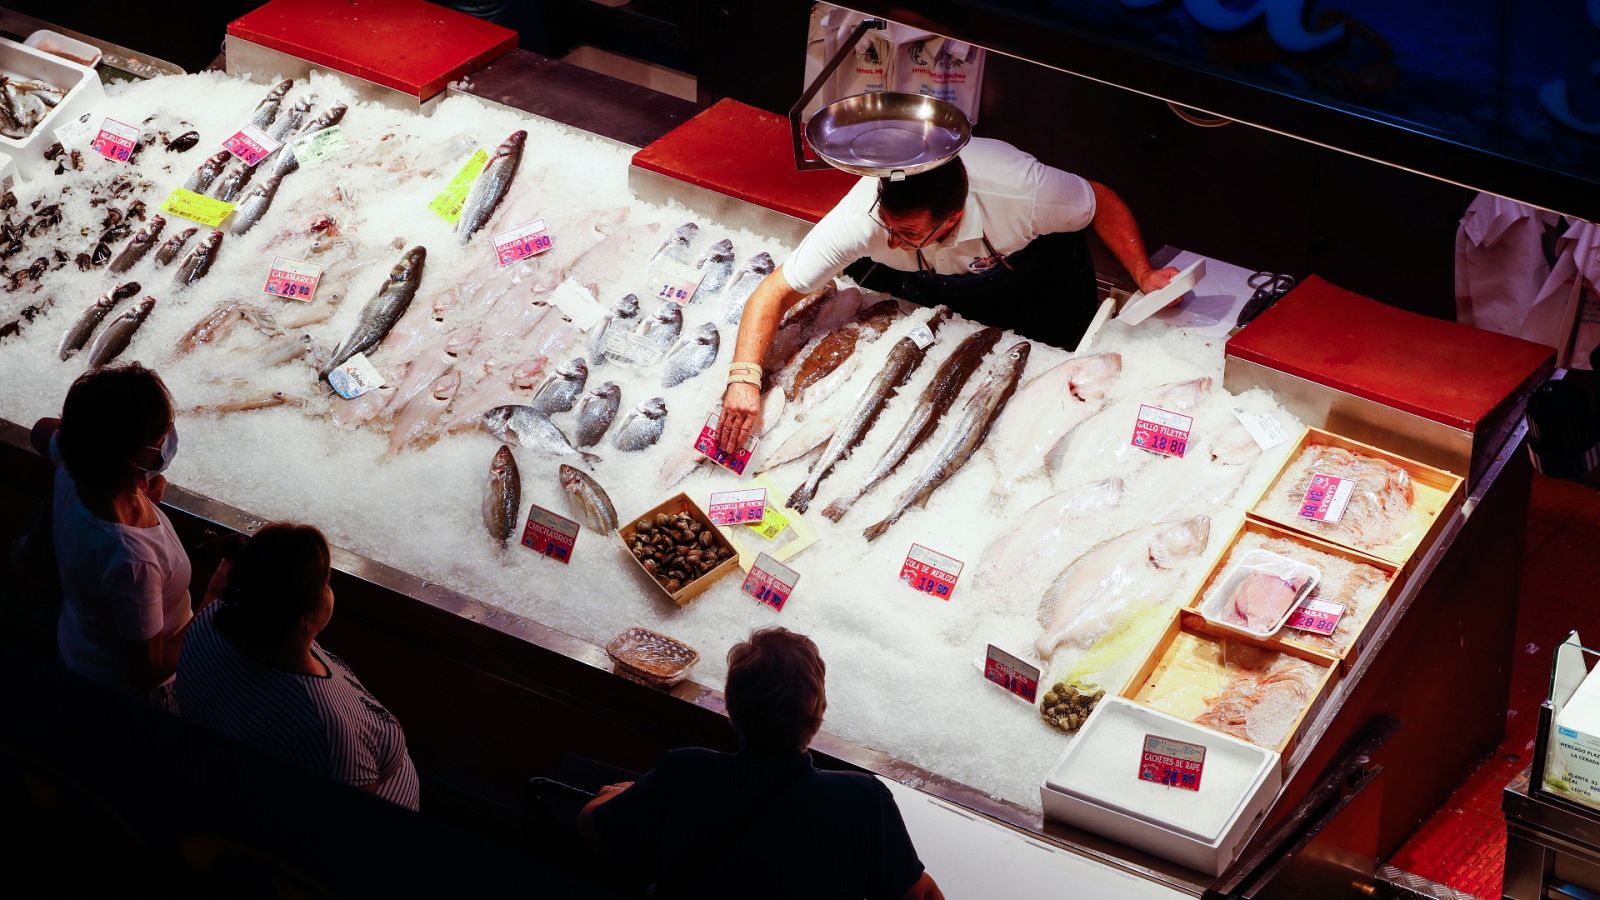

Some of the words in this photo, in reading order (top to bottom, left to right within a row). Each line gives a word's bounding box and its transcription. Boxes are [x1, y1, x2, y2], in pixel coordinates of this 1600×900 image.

[497, 239, 521, 251] GALLOS
[271, 270, 315, 283] CALAMARES
[1137, 420, 1158, 432] GALLO
[1160, 426, 1187, 439] FILETES
[1318, 484, 1336, 512] GAMBAS
[528, 521, 573, 546] CHICHARROS
[905, 558, 920, 570] COLA
[921, 564, 930, 574] DE
[931, 569, 956, 585] MERLUZA
[1317, 620, 1334, 631] 80
[1560, 742, 1586, 754] MERCADO
[1144, 752, 1174, 766] CACHETES
[1175, 759, 1184, 768] DE
[1185, 761, 1201, 772] RAPE
[1579, 755, 1600, 766] CEBADA
[1561, 776, 1578, 785] LOCAL
[1568, 772, 1589, 783] PLANTA
[1571, 786, 1591, 797] CENTRO
